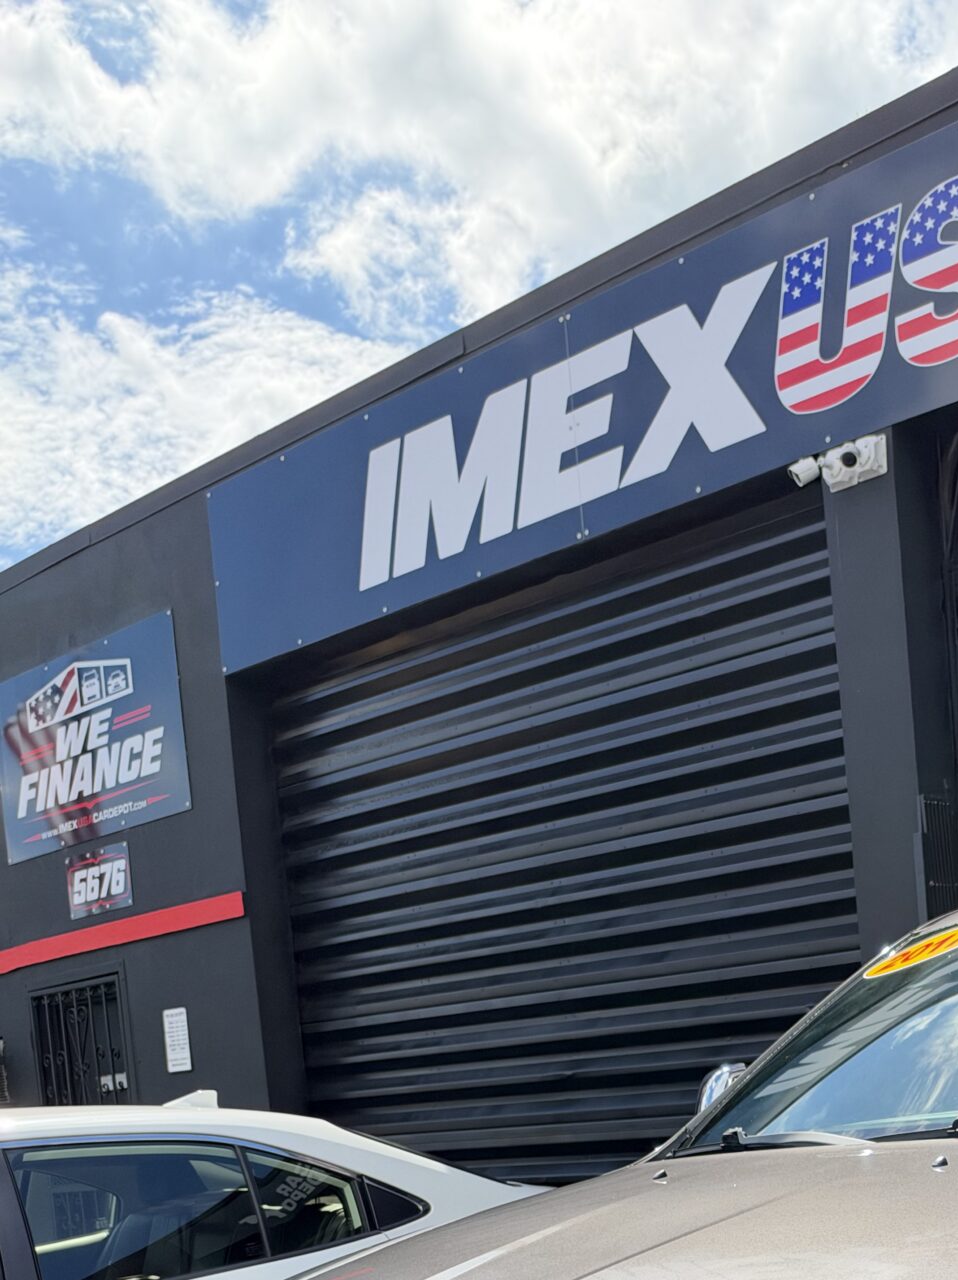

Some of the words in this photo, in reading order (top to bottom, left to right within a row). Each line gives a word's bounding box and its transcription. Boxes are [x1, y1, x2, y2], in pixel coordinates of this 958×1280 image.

[54, 707, 113, 763] WE
[17, 726, 165, 819] FINANCE
[72, 858, 127, 905] 5676
